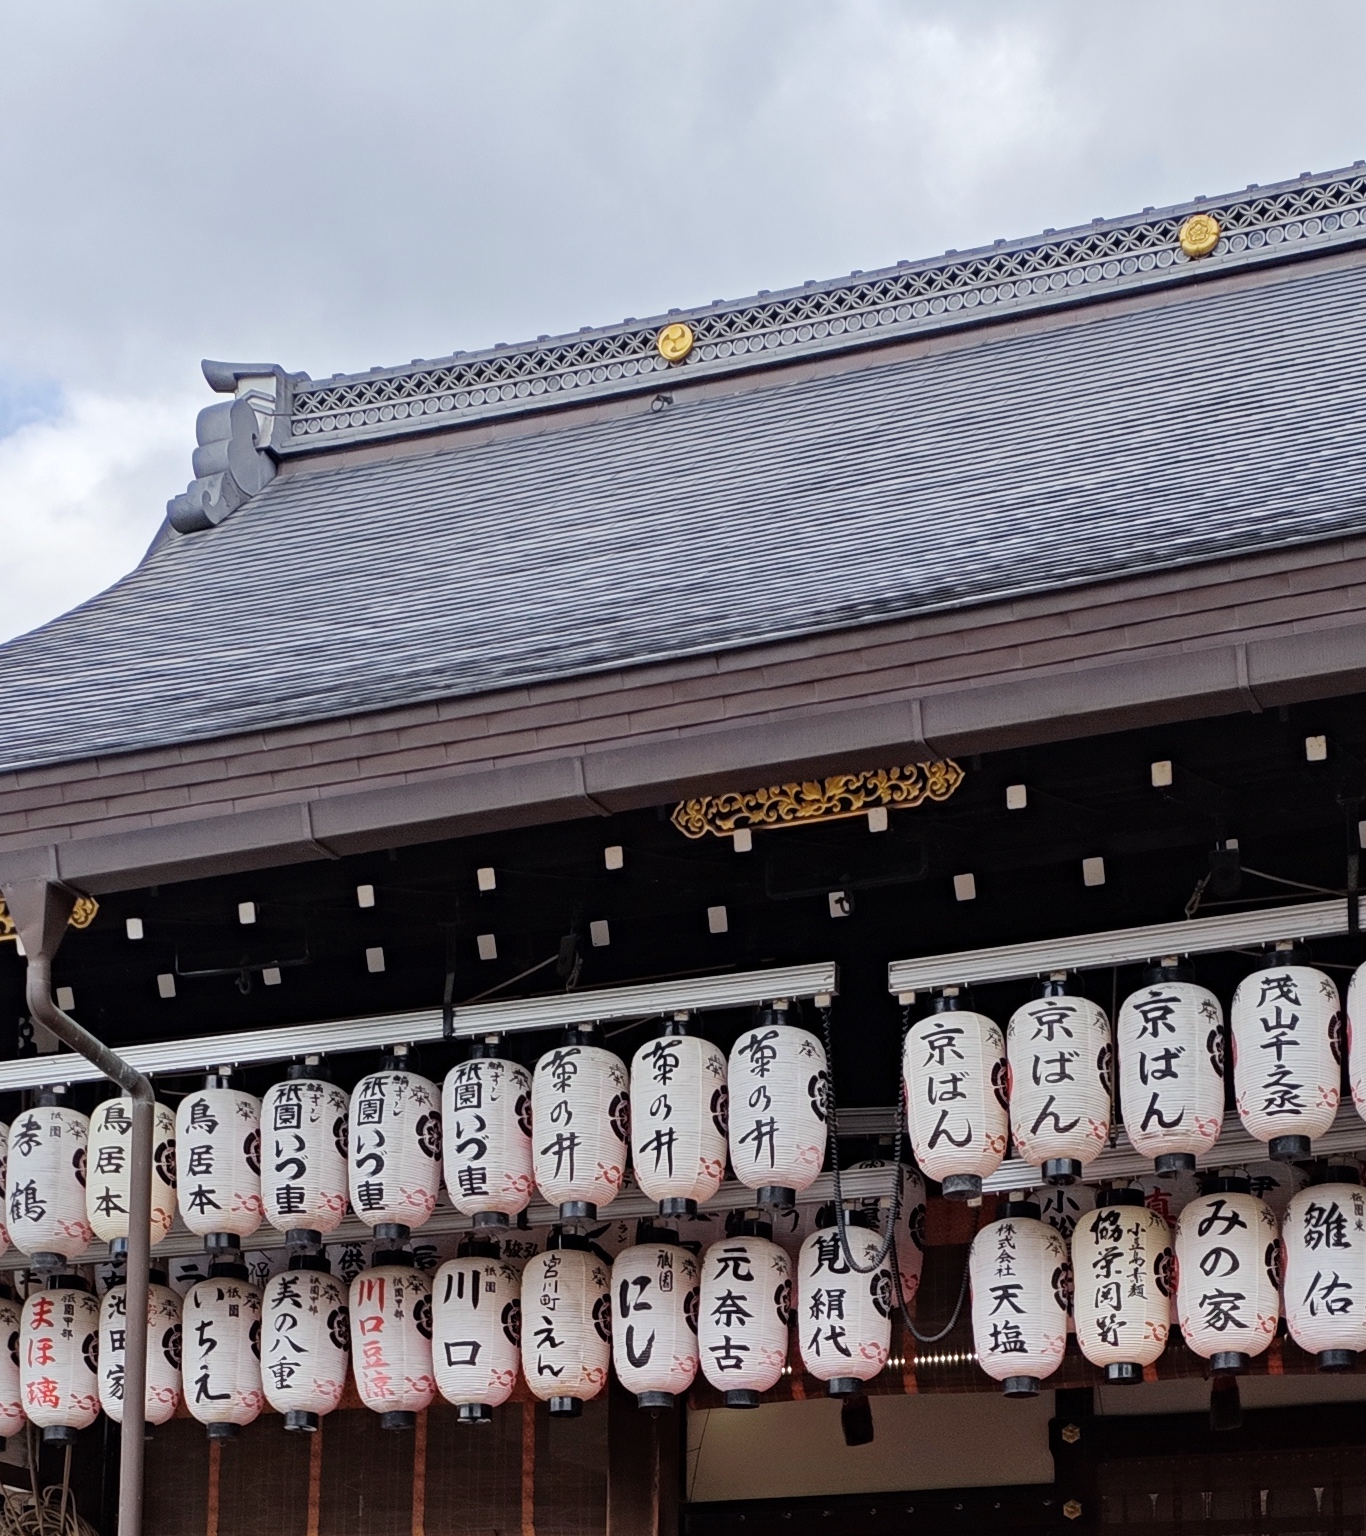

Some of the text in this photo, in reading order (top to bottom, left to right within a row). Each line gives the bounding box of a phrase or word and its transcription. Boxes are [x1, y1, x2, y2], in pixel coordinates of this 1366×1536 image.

[920, 1023, 972, 1150] 京ばん
[1028, 1001, 1080, 1135] 京ばん
[1133, 991, 1186, 1132] 京ばん
[1256, 974, 1307, 1116] 茂山千之丞
[94, 1102, 132, 1217] 鳥居本
[186, 1098, 223, 1215] 鳥居本
[443, 1269, 482, 1367] 川口
[619, 1275, 656, 1368] にし
[709, 1247, 755, 1372] 元奈古
[1198, 1199, 1249, 1332] みの家
[268, 1276, 309, 1390] 美の八重
